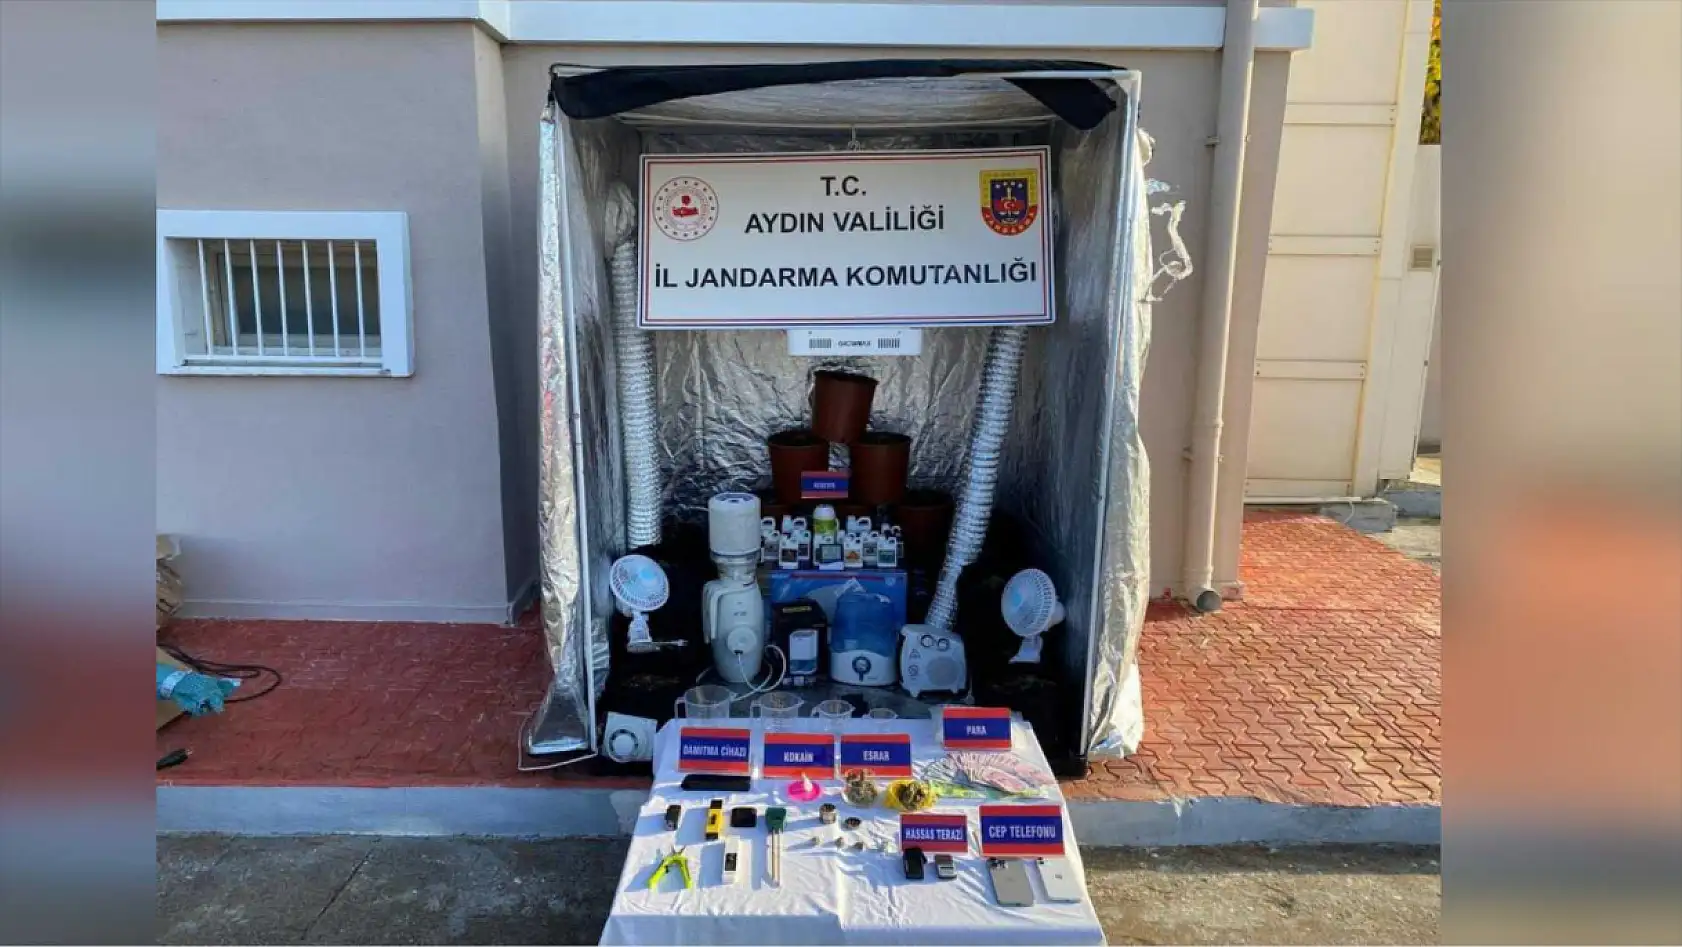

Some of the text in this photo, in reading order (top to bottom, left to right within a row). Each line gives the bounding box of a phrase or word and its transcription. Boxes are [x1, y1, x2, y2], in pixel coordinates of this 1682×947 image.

[820, 175, 867, 197] T.C.
[744, 205, 944, 234] AYDIN VALİLİĞİ
[655, 257, 1036, 288] İL JANDARMA KOMUTANLIĞI
[863, 750, 890, 761] ESRAR
[905, 827, 935, 840] HASSAS
[988, 824, 1056, 839] CEP TELEFONU
